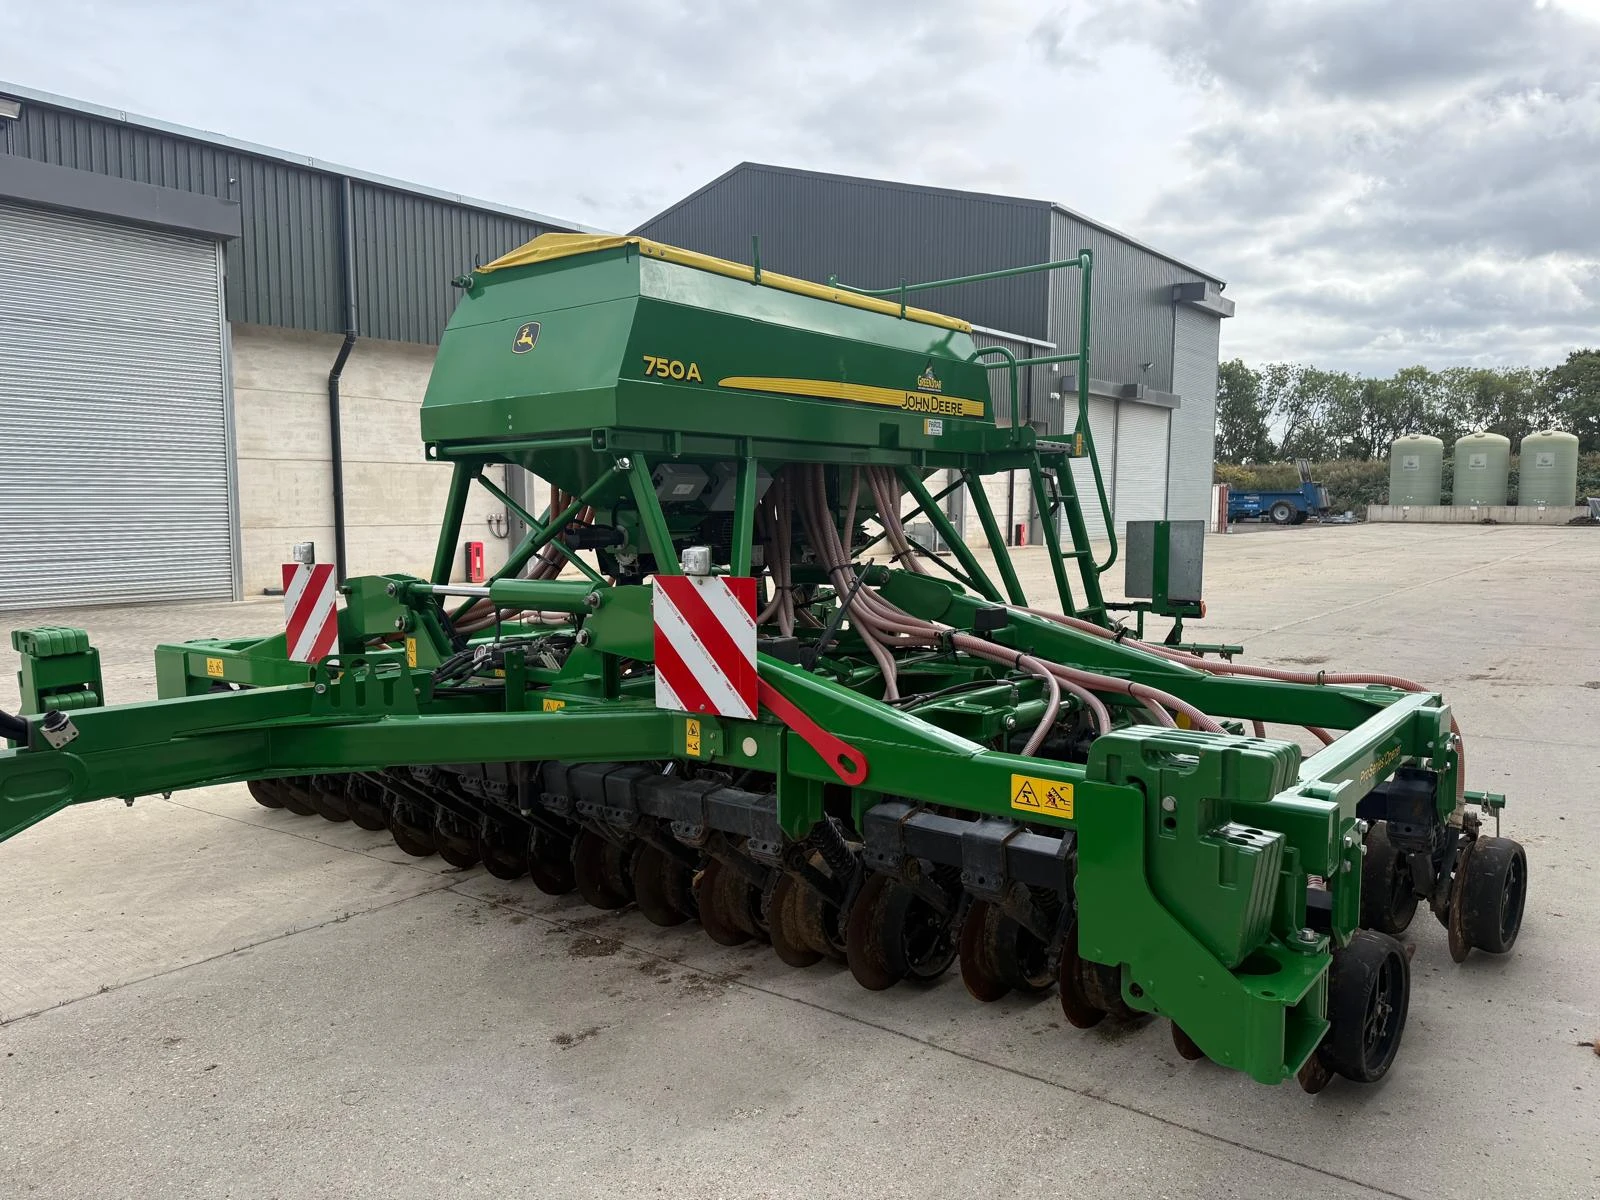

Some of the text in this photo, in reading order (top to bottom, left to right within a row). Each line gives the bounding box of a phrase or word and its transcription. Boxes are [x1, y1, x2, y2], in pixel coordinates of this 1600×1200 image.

[643, 355, 702, 382] 750A
[901, 393, 963, 415] JOHN DEERE
